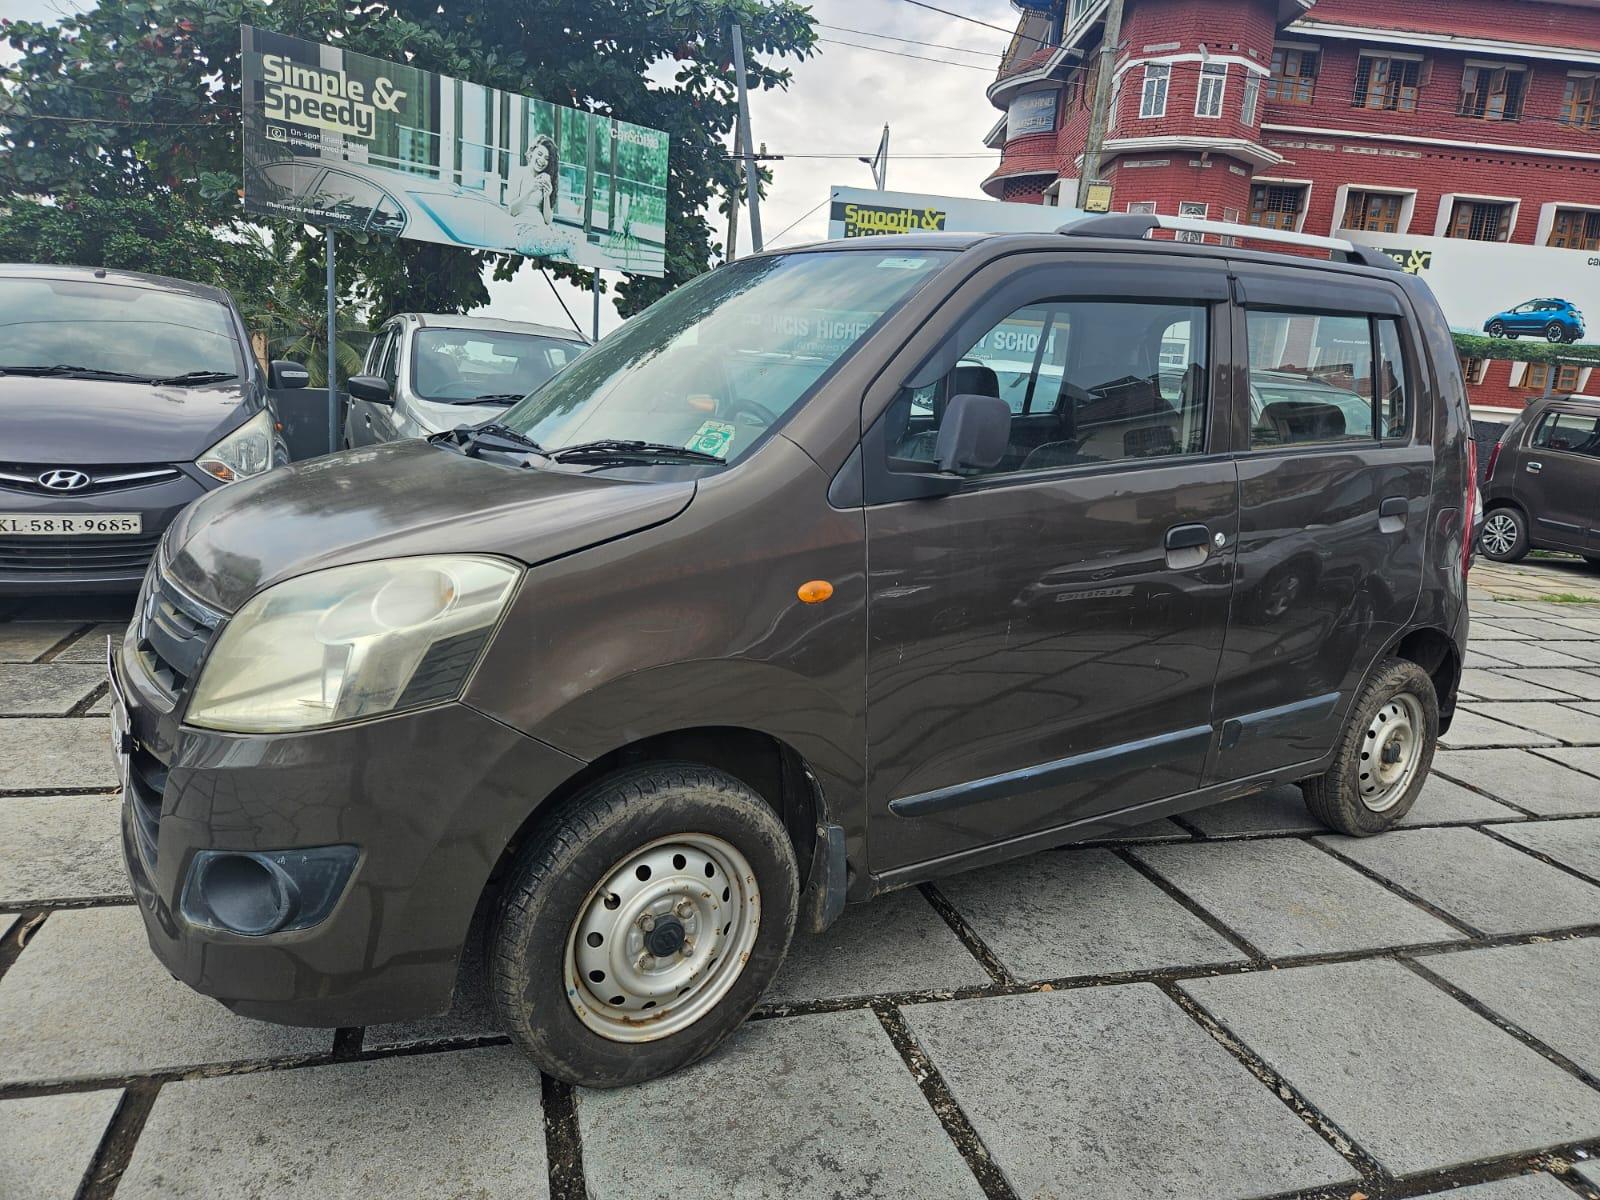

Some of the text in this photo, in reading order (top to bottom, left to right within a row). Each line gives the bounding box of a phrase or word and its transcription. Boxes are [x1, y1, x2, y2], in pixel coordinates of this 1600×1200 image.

[263, 54, 407, 113] Simple &
[265, 84, 373, 136] Speedy
[845, 204, 945, 231] Smooth &
[817, 318, 872, 342] HIGHE
